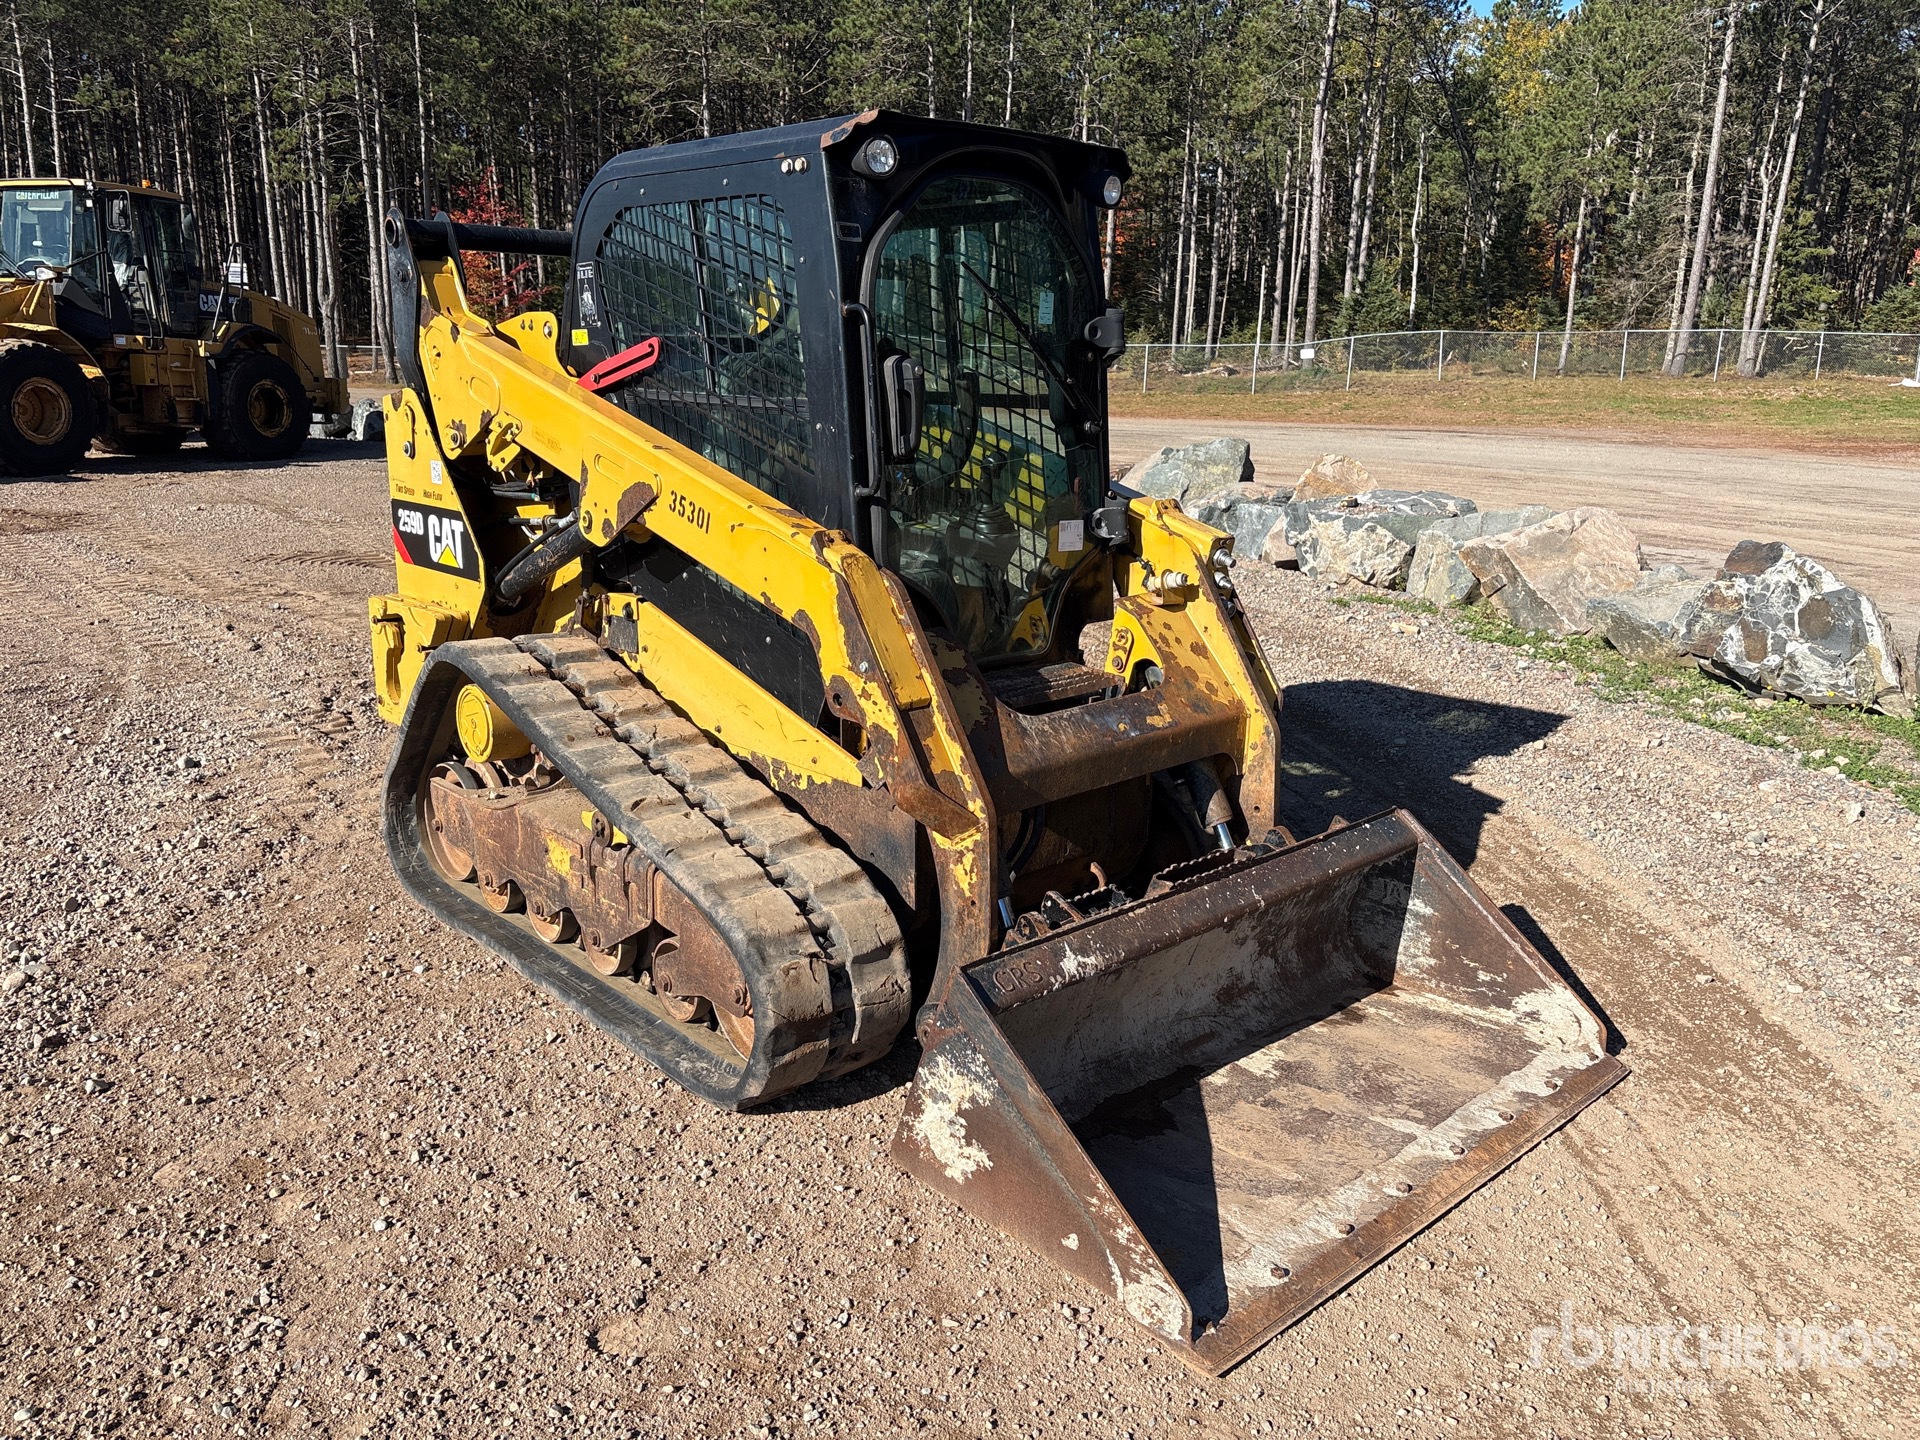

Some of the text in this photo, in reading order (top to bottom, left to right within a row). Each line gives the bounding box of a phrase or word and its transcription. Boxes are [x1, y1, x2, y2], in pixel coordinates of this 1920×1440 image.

[15, 190, 60, 200] CATERPILLAR
[397, 507, 425, 536] 259D
[668, 489, 711, 535] 35301
[427, 514, 464, 570] CAT
[992, 960, 1044, 993] CRS
